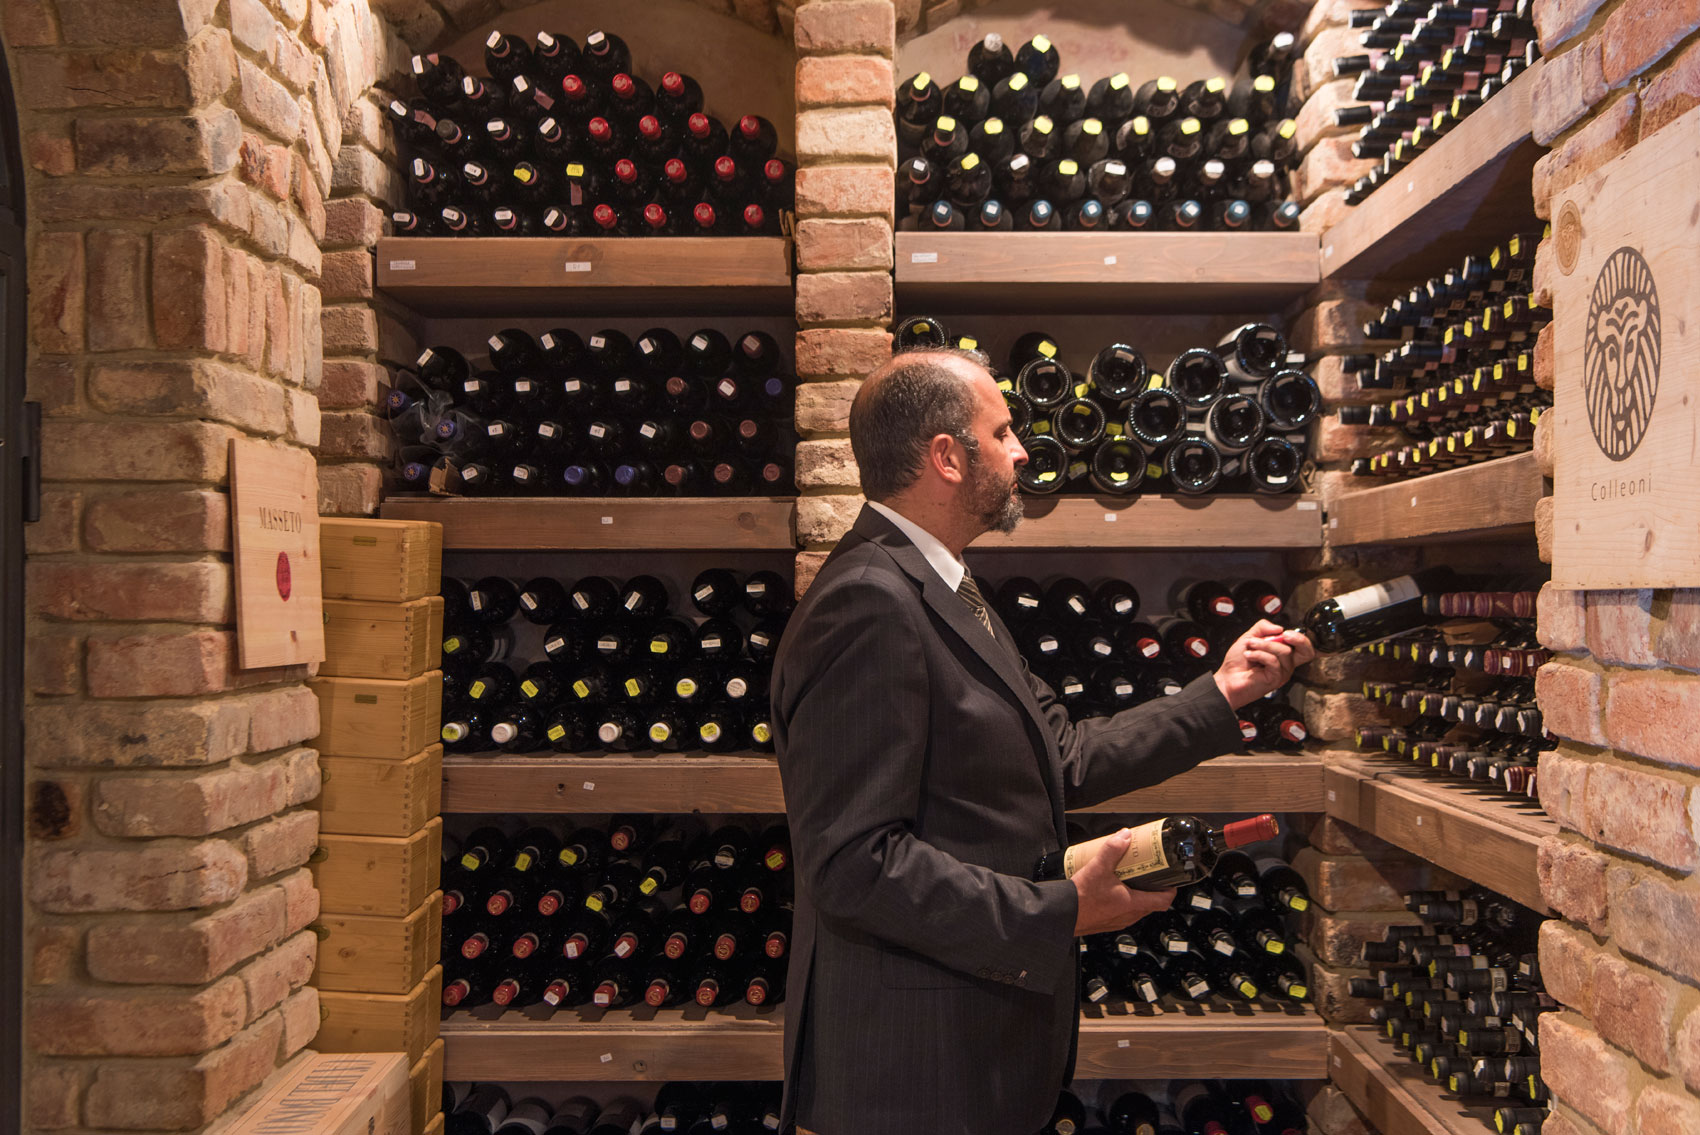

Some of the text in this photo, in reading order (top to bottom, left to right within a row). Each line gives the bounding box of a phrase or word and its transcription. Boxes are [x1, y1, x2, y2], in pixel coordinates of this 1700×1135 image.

[1591, 473, 1652, 501] Colleoni
[258, 506, 302, 534] MASSETO
[288, 1075, 364, 1096] DEL
[251, 1098, 341, 1134] BOSCO
